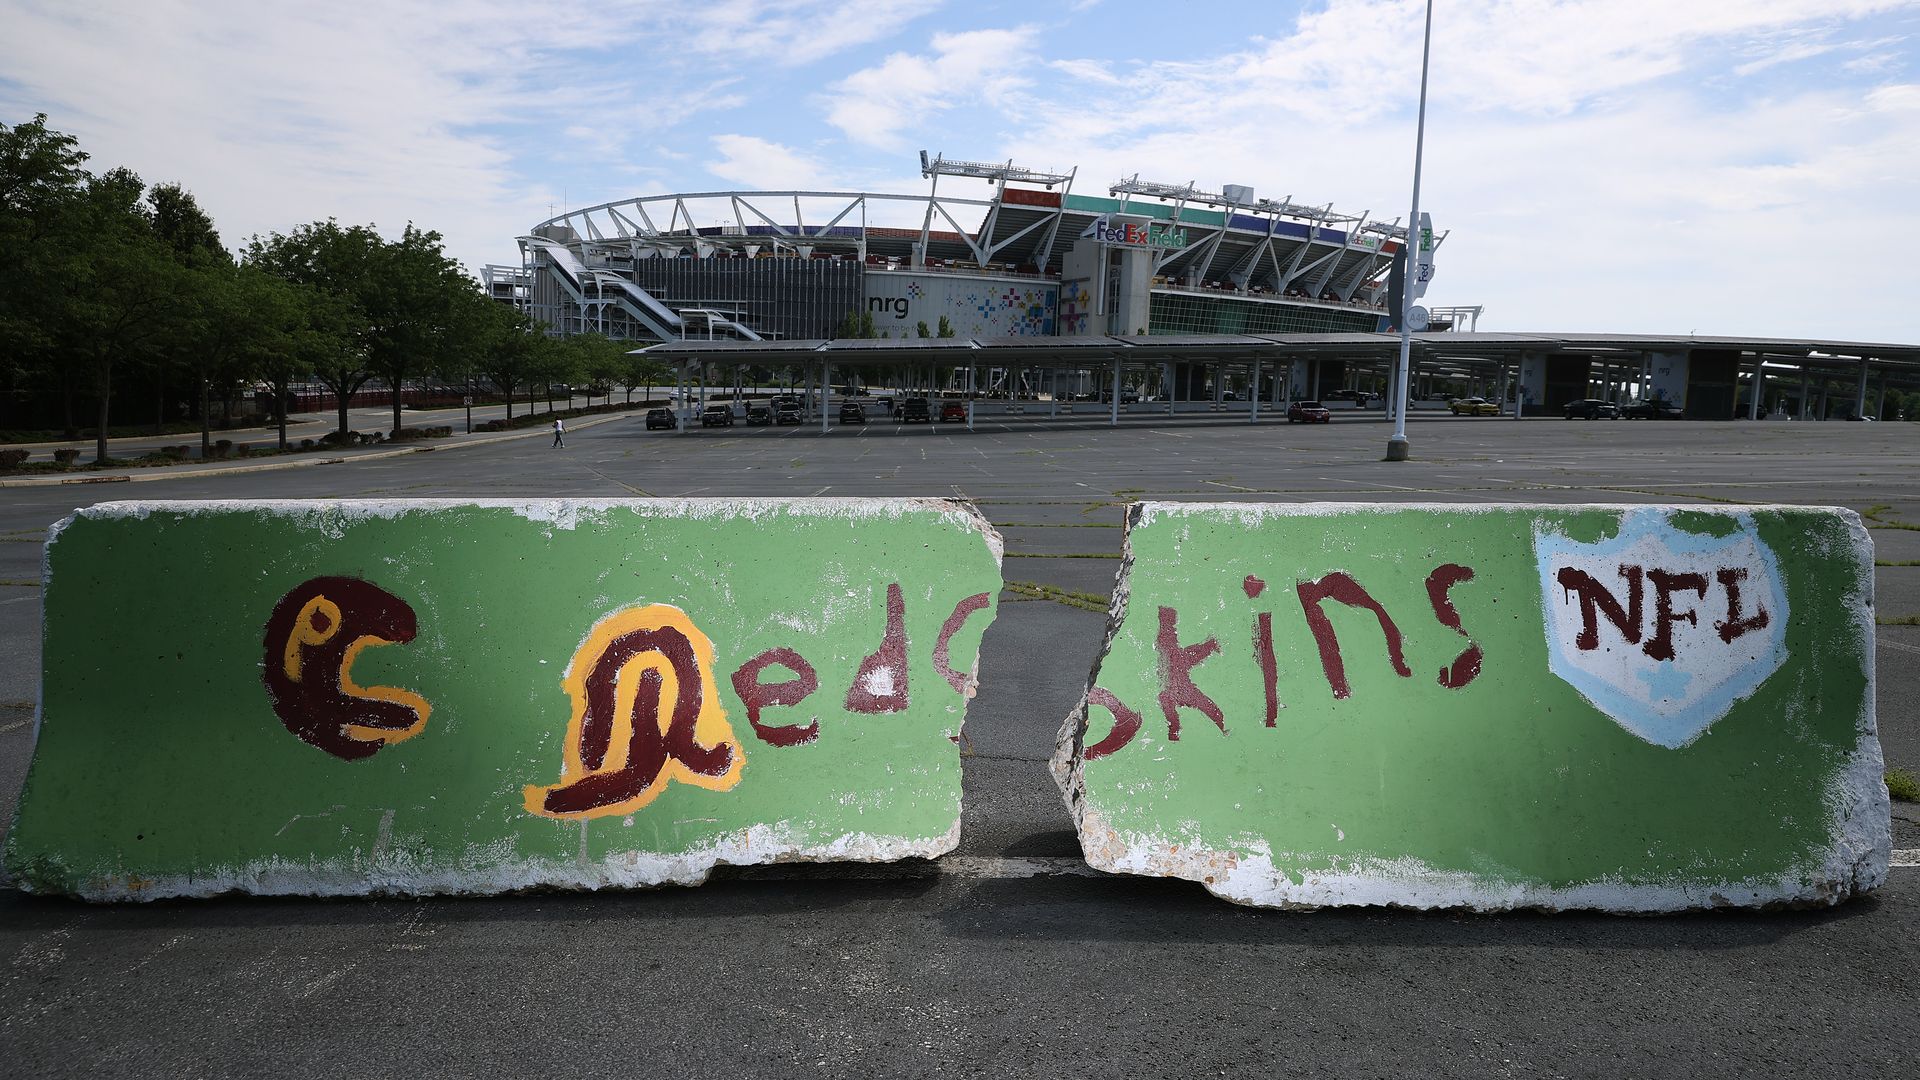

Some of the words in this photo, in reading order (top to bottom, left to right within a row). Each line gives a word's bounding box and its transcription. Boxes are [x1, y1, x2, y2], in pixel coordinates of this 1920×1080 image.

[1096, 220, 1188, 248] FedExField
[1420, 228, 1431, 251] Field
[1418, 263, 1429, 282] Fed
[869, 296, 909, 319] nrg
[1557, 564, 1770, 662] NFL
